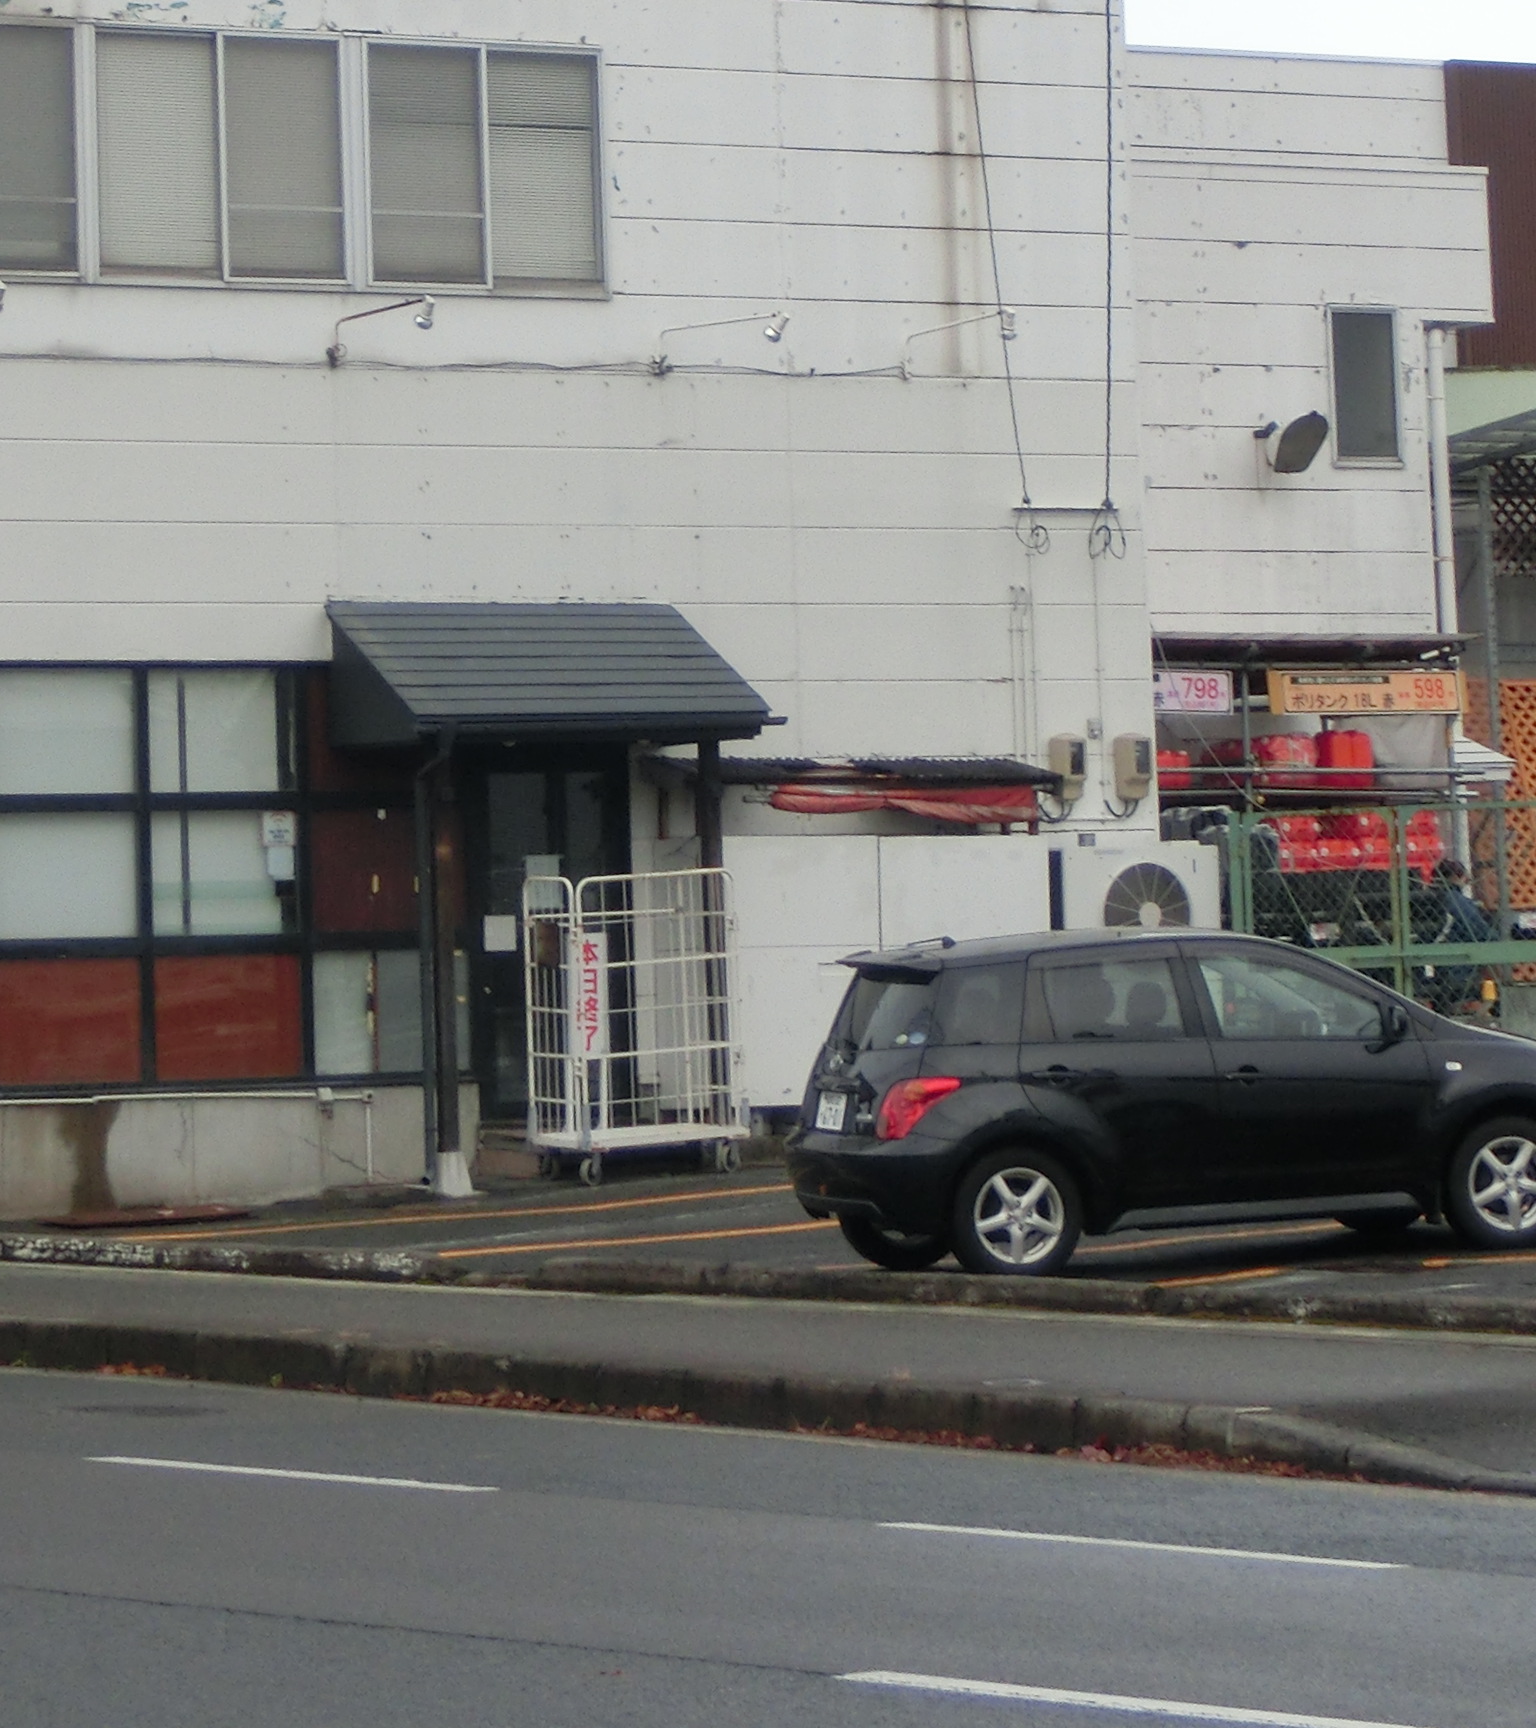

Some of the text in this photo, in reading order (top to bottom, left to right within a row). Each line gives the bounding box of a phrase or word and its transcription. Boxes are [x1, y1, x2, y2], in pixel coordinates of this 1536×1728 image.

[1181, 676, 1219, 700] 798
[1413, 678, 1445, 699] 598
[1291, 692, 1349, 709] ポリタンク
